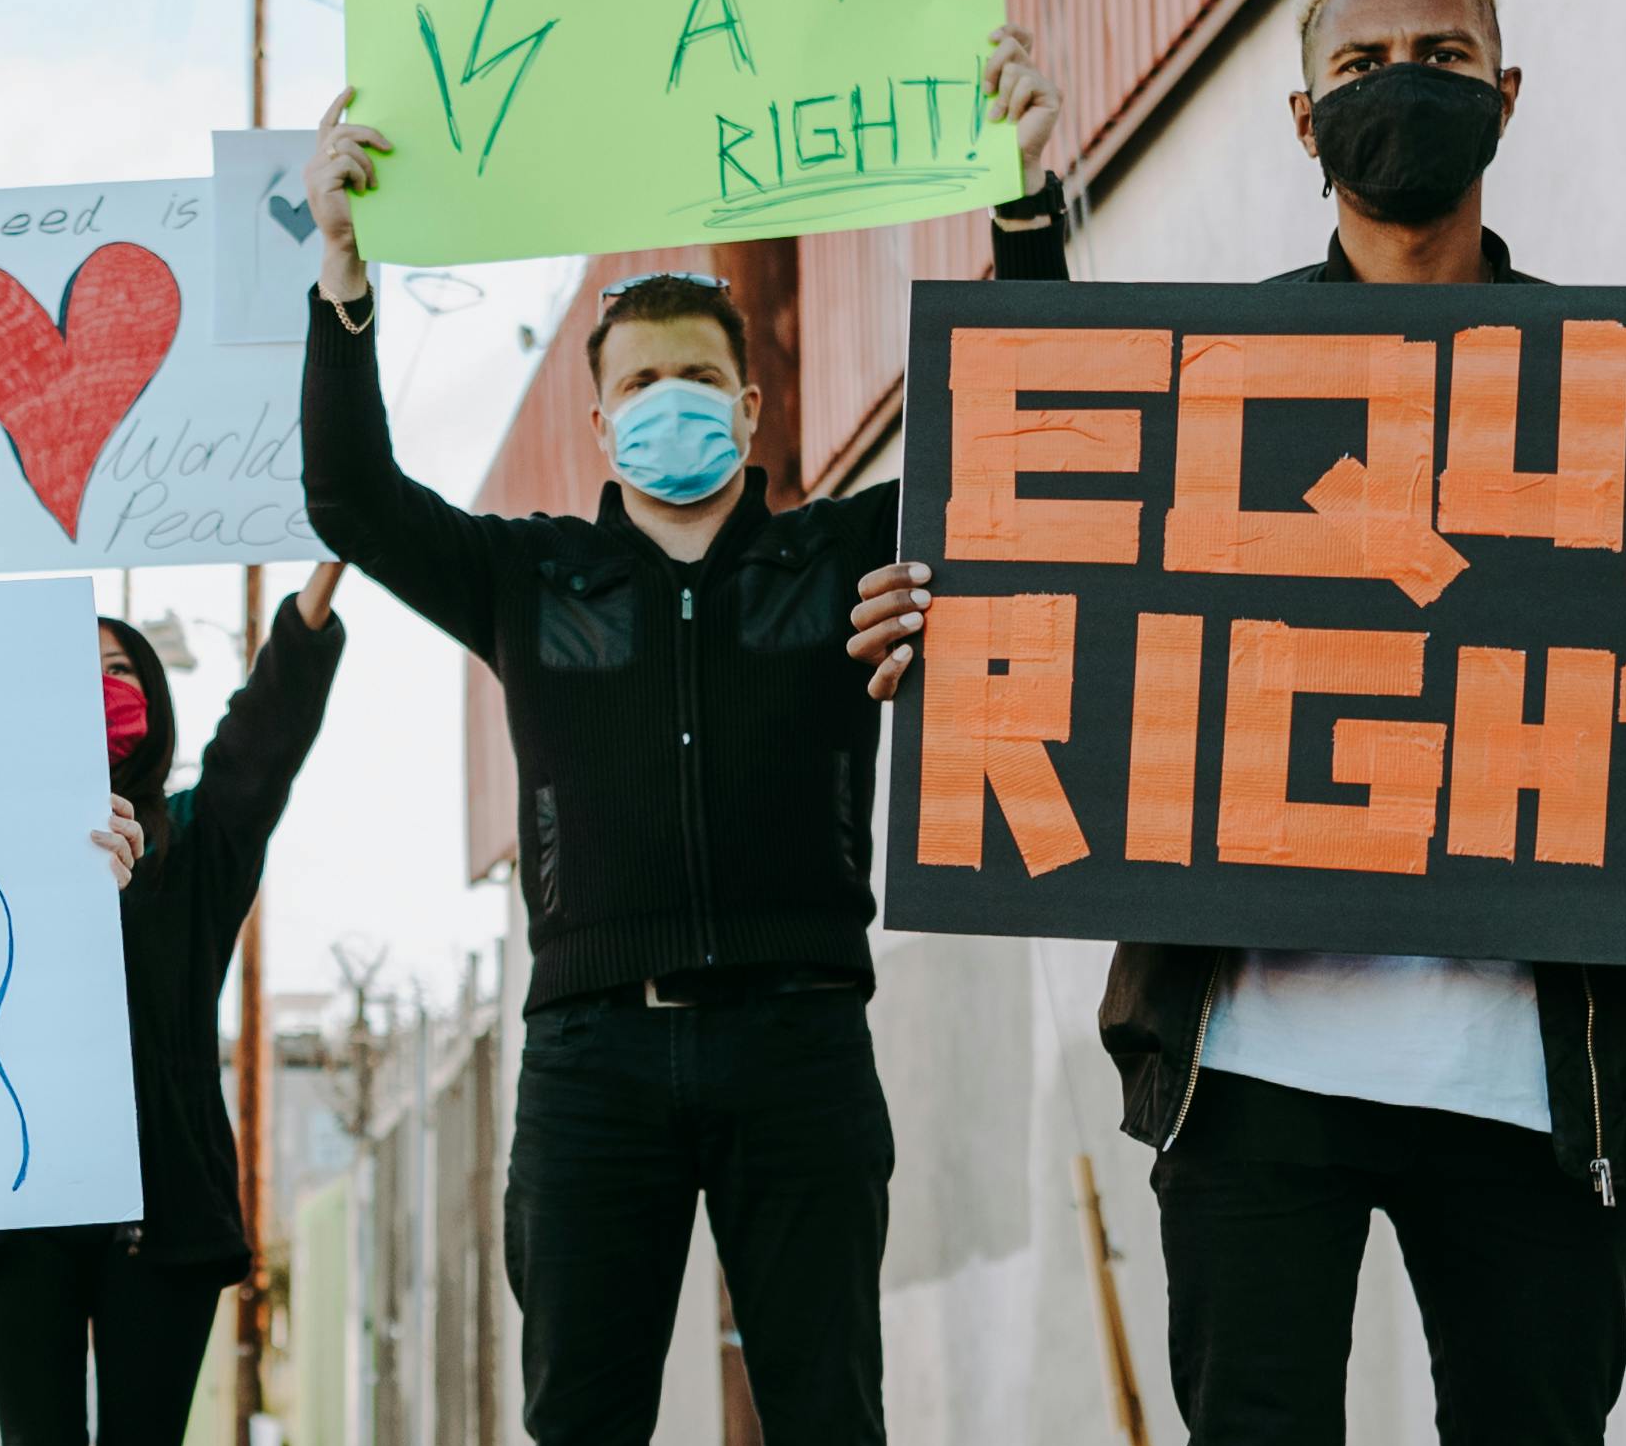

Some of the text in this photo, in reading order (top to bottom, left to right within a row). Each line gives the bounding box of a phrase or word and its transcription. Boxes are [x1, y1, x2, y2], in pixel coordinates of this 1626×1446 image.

[714, 55, 987, 203] RIGHT!
[161, 191, 199, 230] is
[100, 401, 303, 482] World
